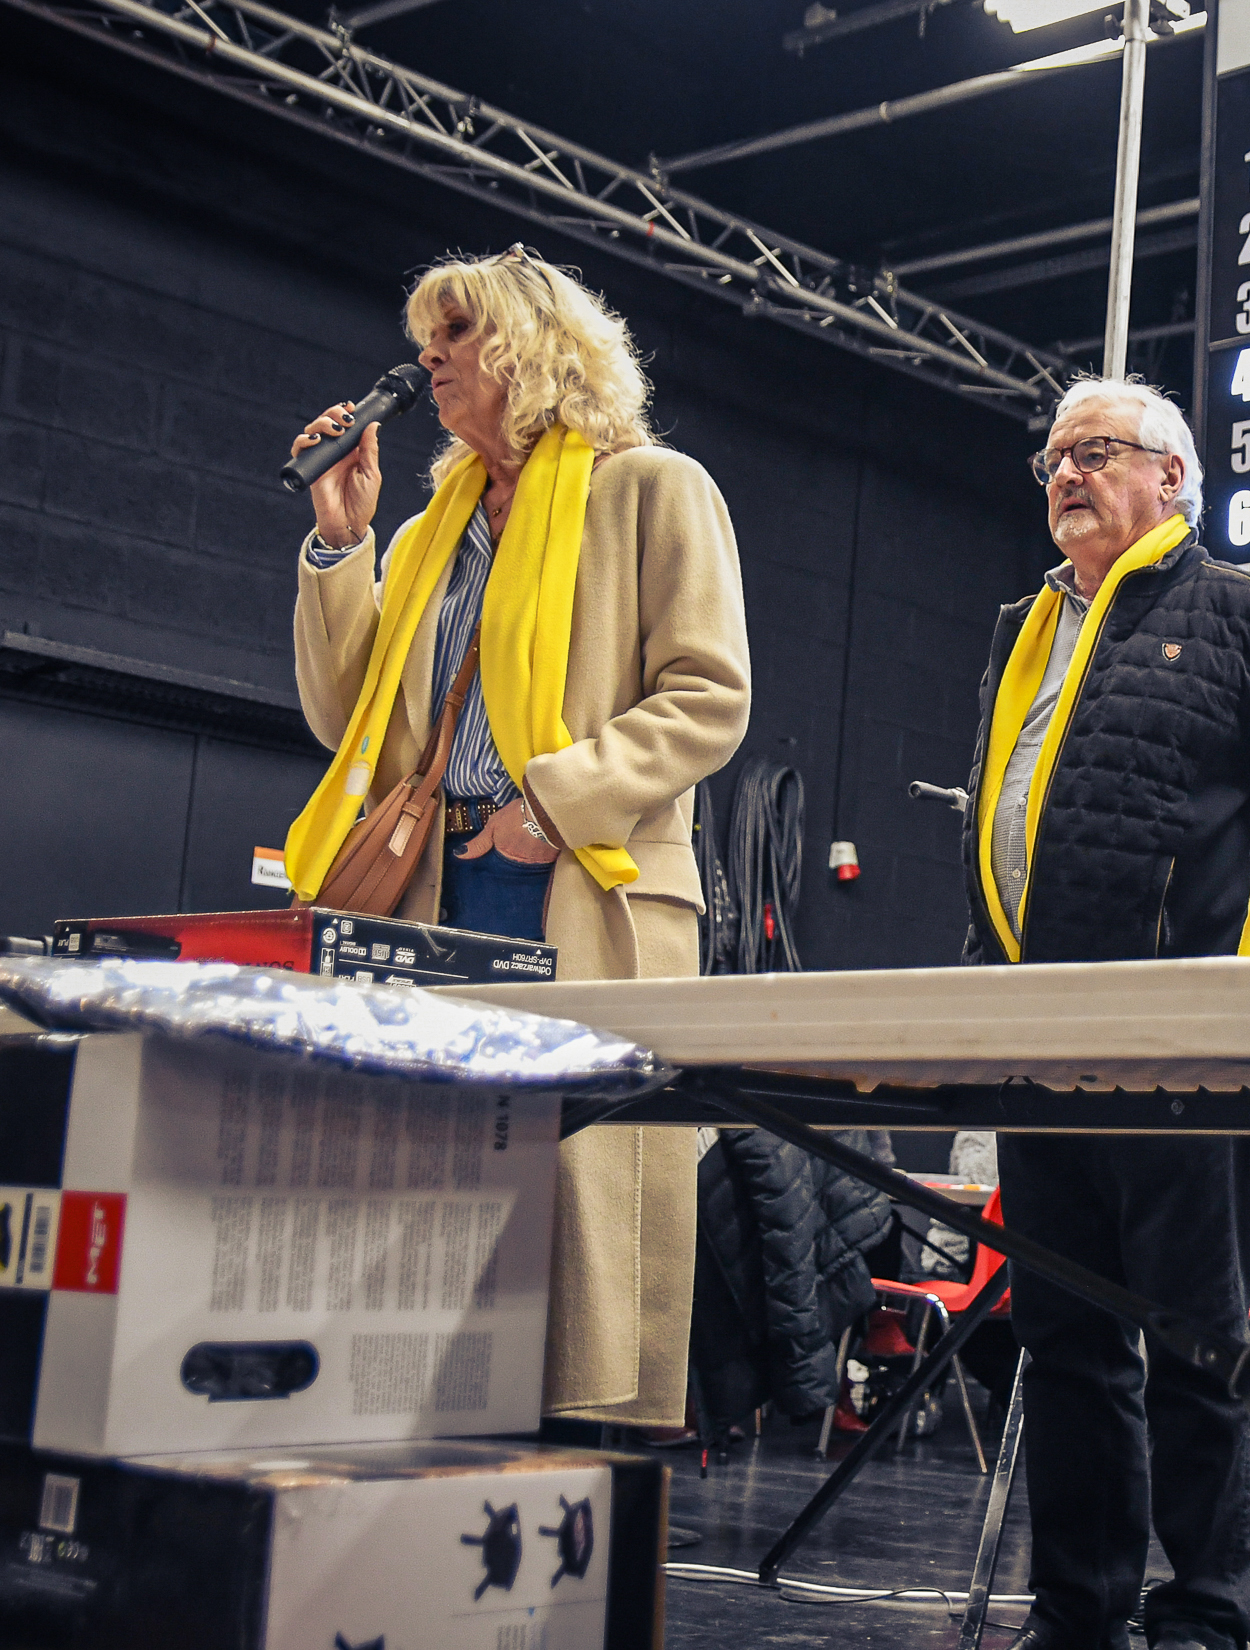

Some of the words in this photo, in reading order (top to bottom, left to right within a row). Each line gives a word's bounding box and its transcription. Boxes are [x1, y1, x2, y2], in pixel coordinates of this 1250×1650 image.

[339, 946, 358, 954] DOLBY
[395, 955, 415, 964] DVD
[493, 959, 510, 969] DVD
[513, 953, 552, 966] DVP-SR760H
[510, 961, 552, 976] Odtwarzacz
